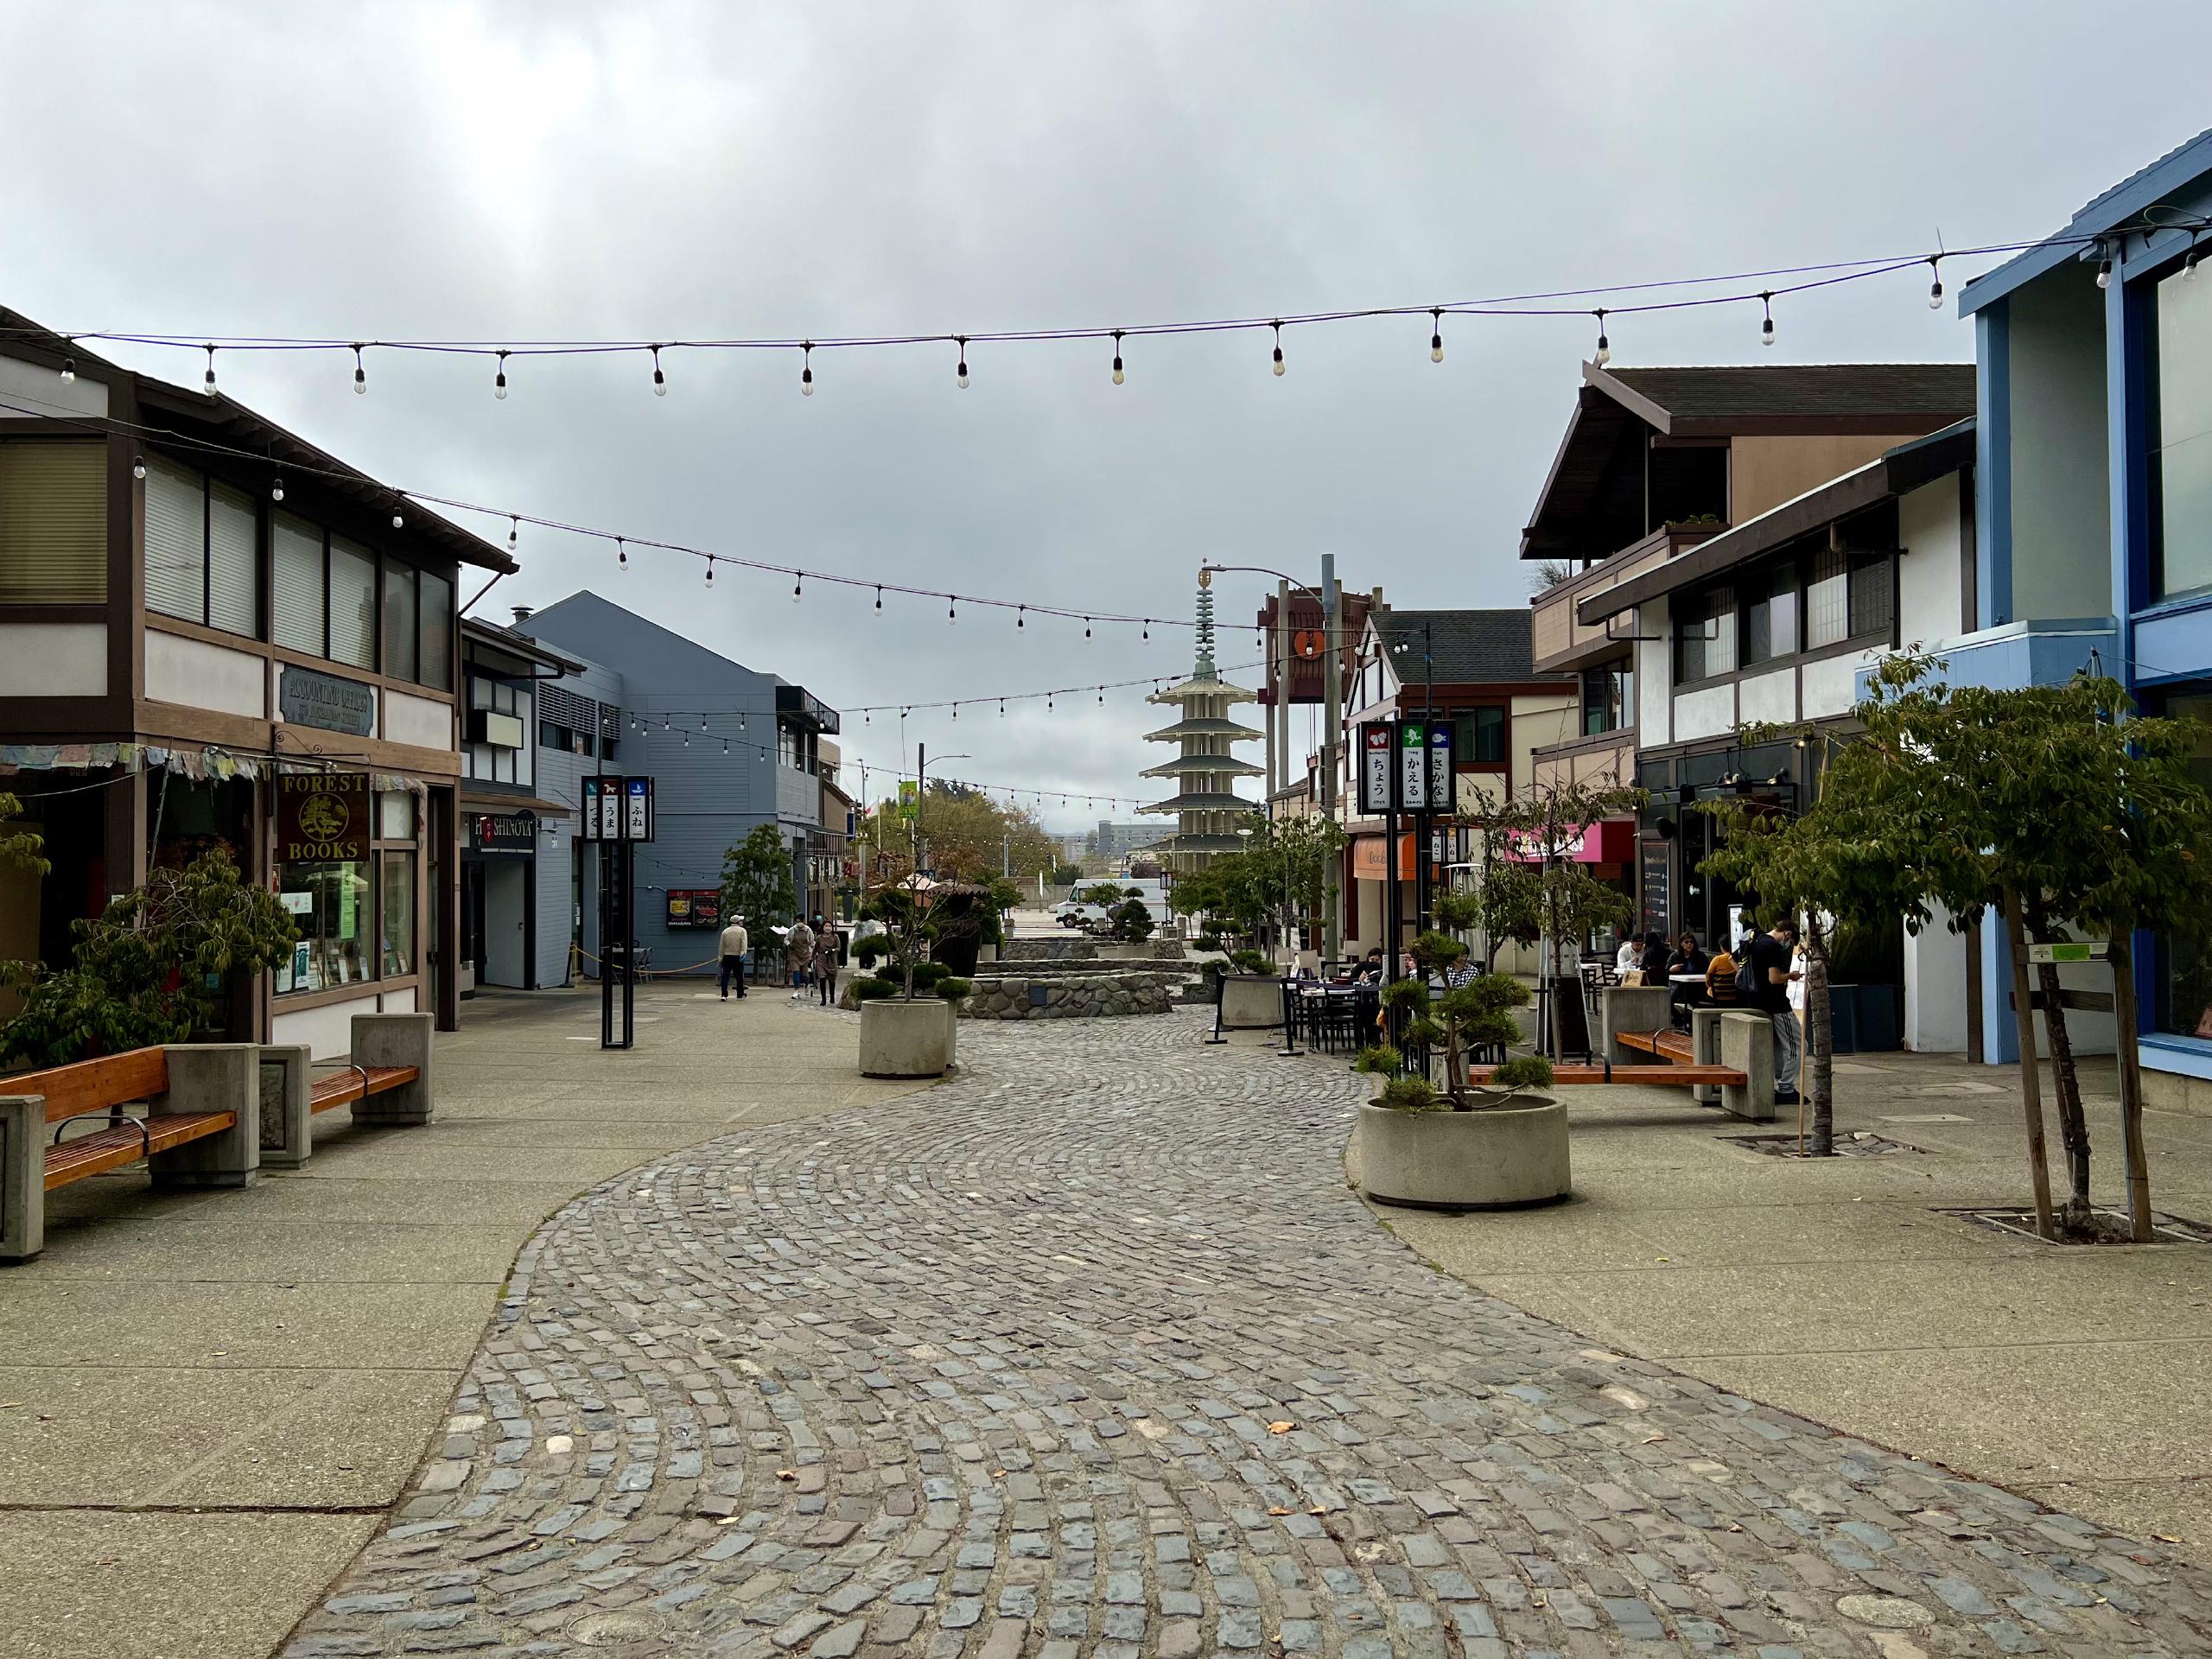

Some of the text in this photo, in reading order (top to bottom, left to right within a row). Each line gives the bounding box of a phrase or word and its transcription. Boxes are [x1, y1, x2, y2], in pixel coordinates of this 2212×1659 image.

[289, 677, 368, 713] ACCOUNTING OFFICES
[283, 775, 365, 792] FOREST
[1374, 759, 1384, 795] ちょう
[1408, 759, 1420, 797] かえる
[1433, 759, 1445, 796] さかな
[607, 806, 615, 828] うま
[632, 805, 643, 827] ふね
[288, 842, 359, 860] BOOKS
